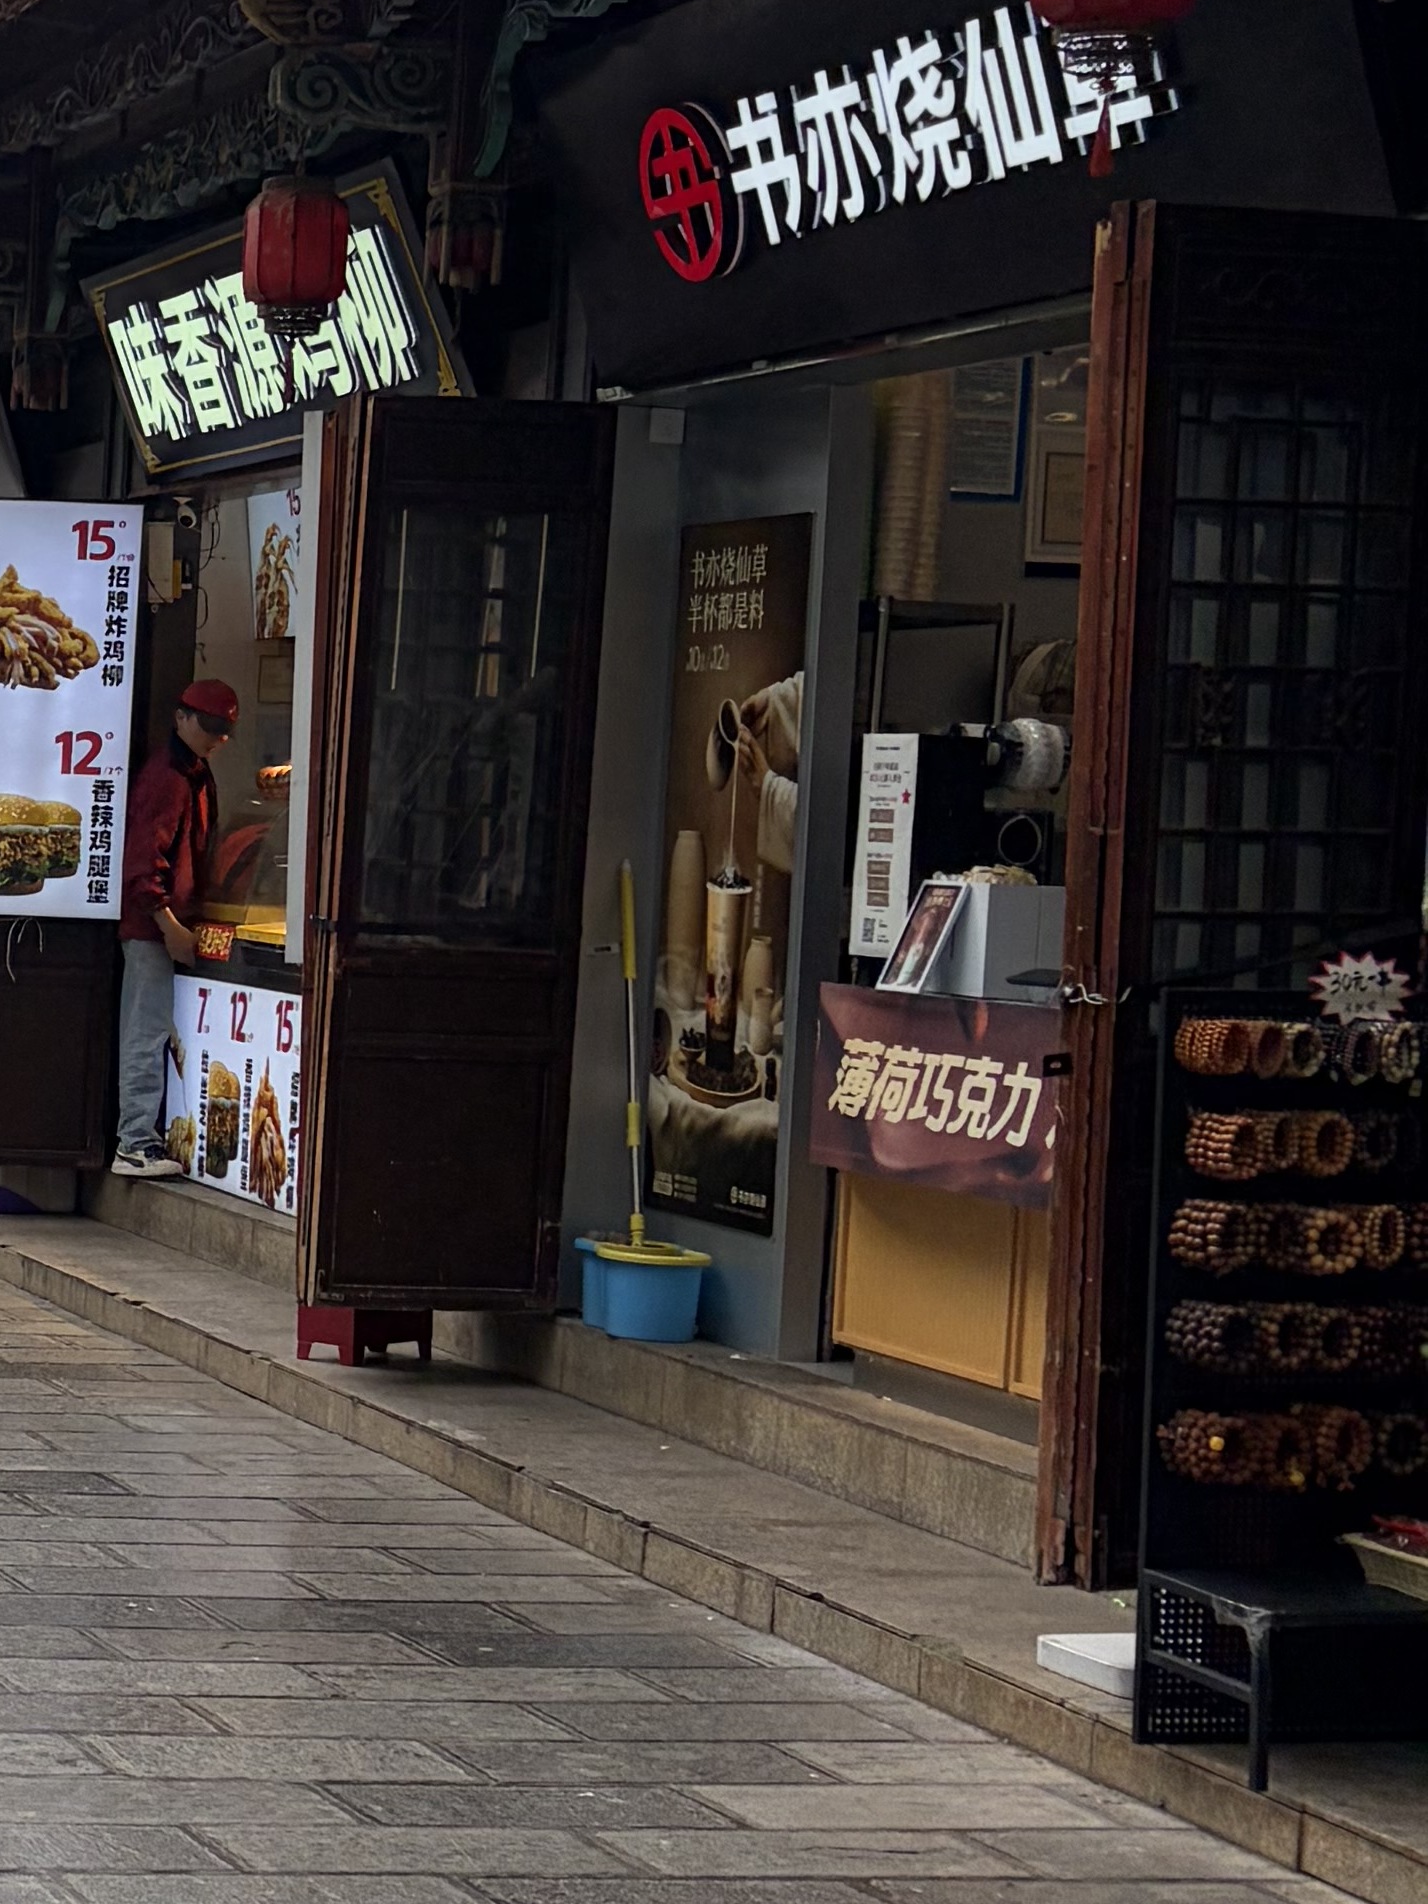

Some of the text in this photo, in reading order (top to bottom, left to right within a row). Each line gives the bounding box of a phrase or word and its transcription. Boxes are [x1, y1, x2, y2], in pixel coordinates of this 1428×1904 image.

[687, 588, 765, 634] 半杯都是料
[690, 543, 769, 589] 书亦烧仙草
[101, 564, 131, 688] 招牌炸鸡柳
[86, 779, 116, 904] 香辣鸡腿堡
[828, 1037, 1056, 1149] 薄荷巧克力
